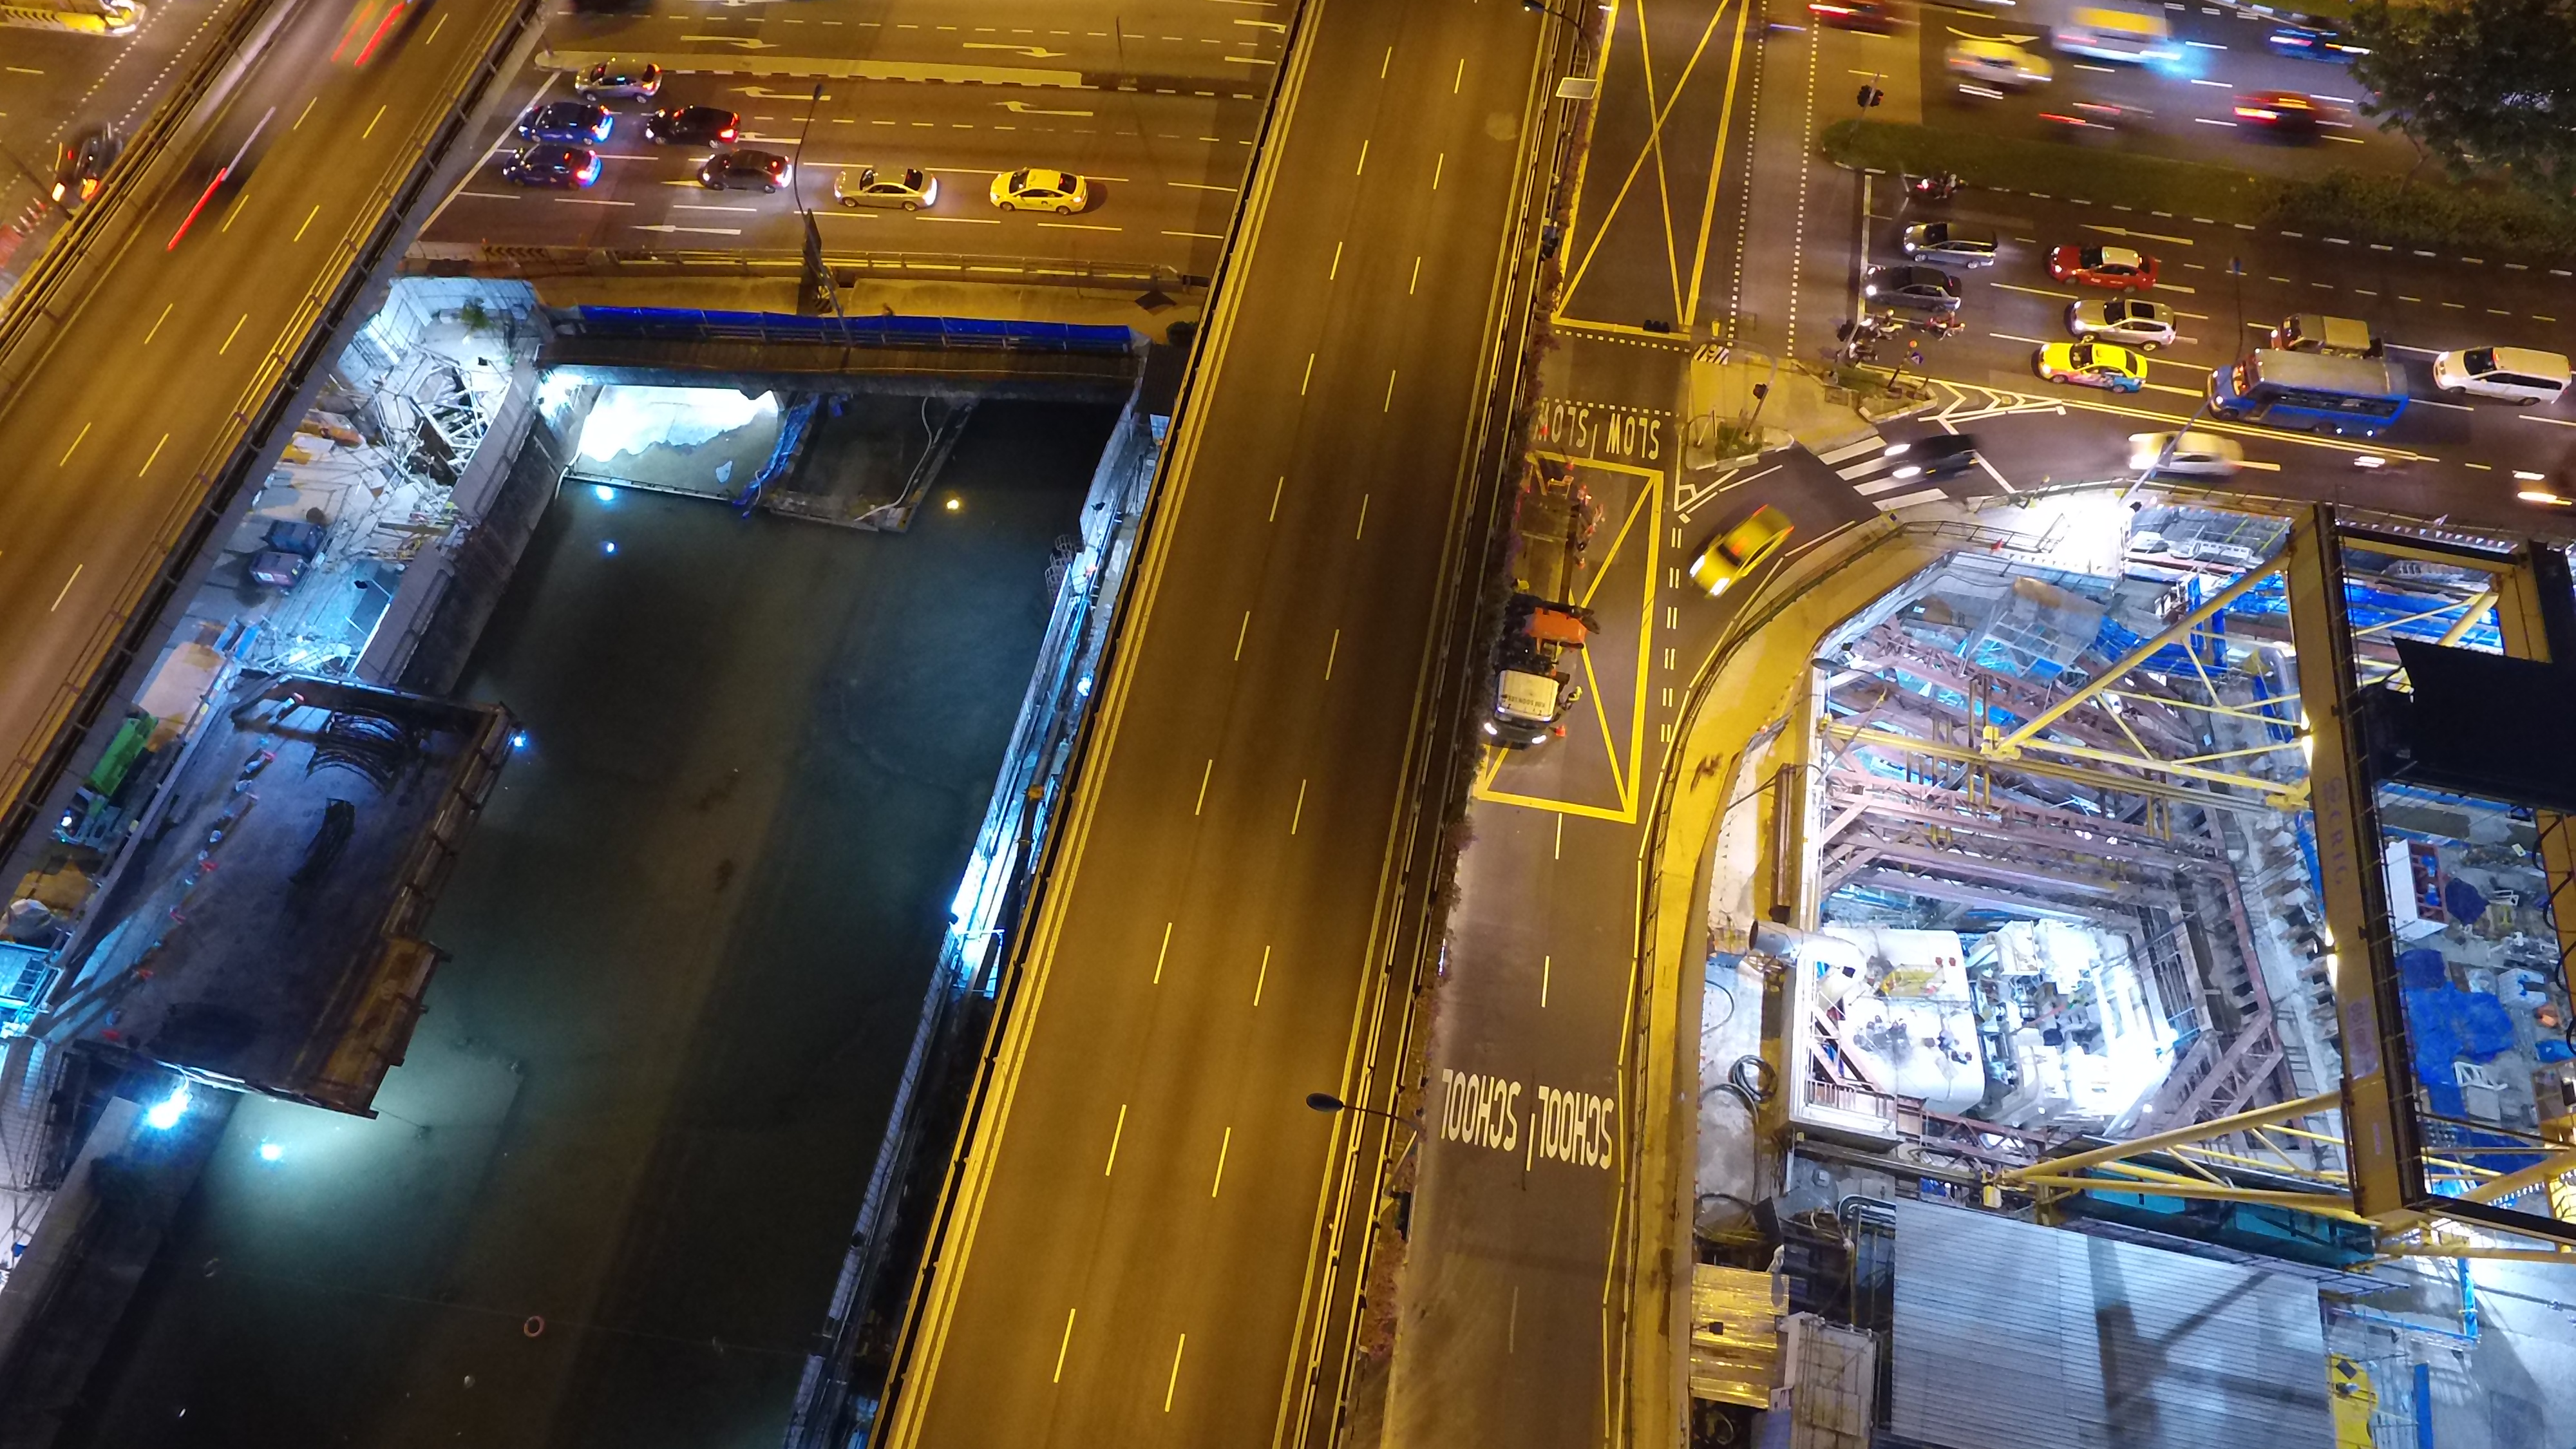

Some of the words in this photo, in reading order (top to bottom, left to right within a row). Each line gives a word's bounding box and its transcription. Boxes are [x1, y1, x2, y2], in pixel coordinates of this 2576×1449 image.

[1533, 401, 1589, 448] SLOW
[1605, 413, 1661, 460] SLOW
[1441, 1068, 1522, 1151] SCHOOL
[1538, 1085, 1615, 1170] SCHOOL
